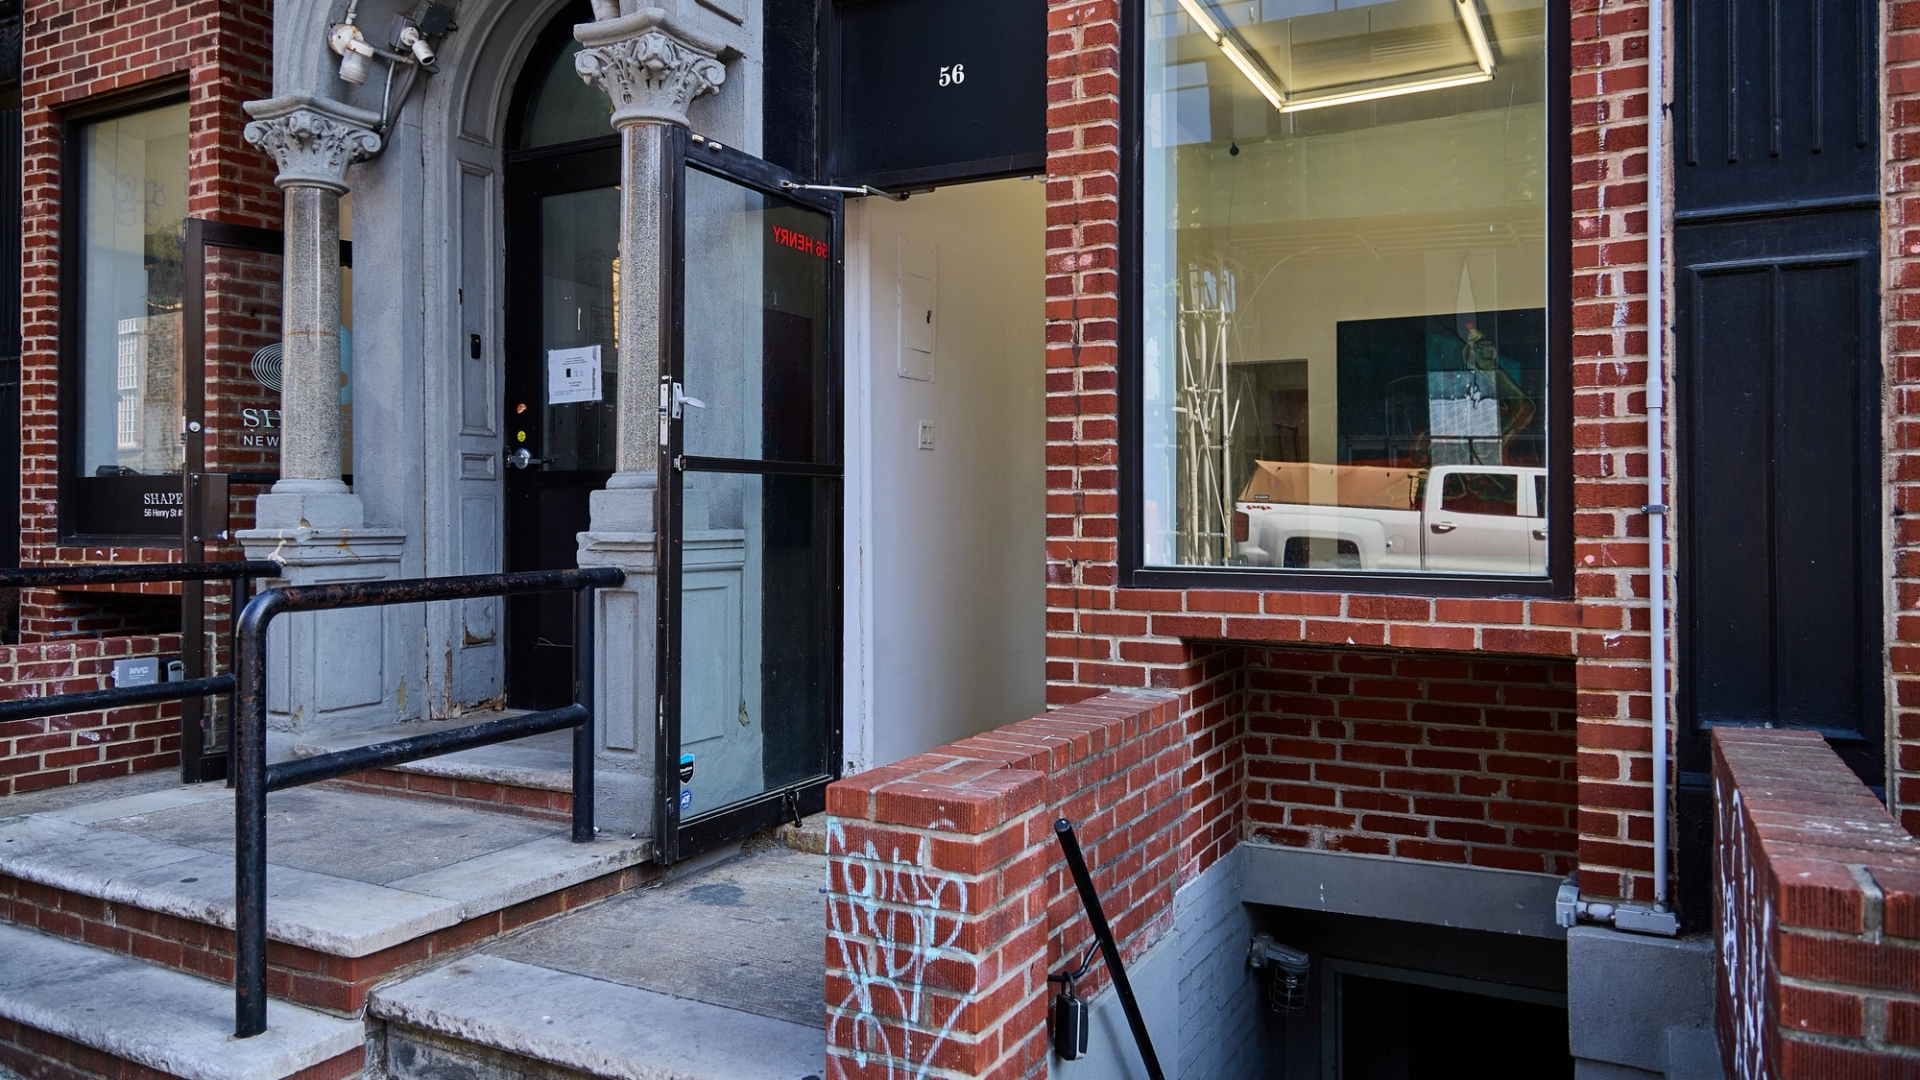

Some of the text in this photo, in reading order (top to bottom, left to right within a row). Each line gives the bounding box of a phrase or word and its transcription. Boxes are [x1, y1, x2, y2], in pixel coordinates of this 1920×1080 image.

[938, 63, 965, 87] 56
[243, 435, 280, 446] NEW
[143, 492, 184, 505] SHAPE
[144, 508, 152, 517] 56
[152, 508, 170, 519] Henry
[170, 508, 178, 517] St
